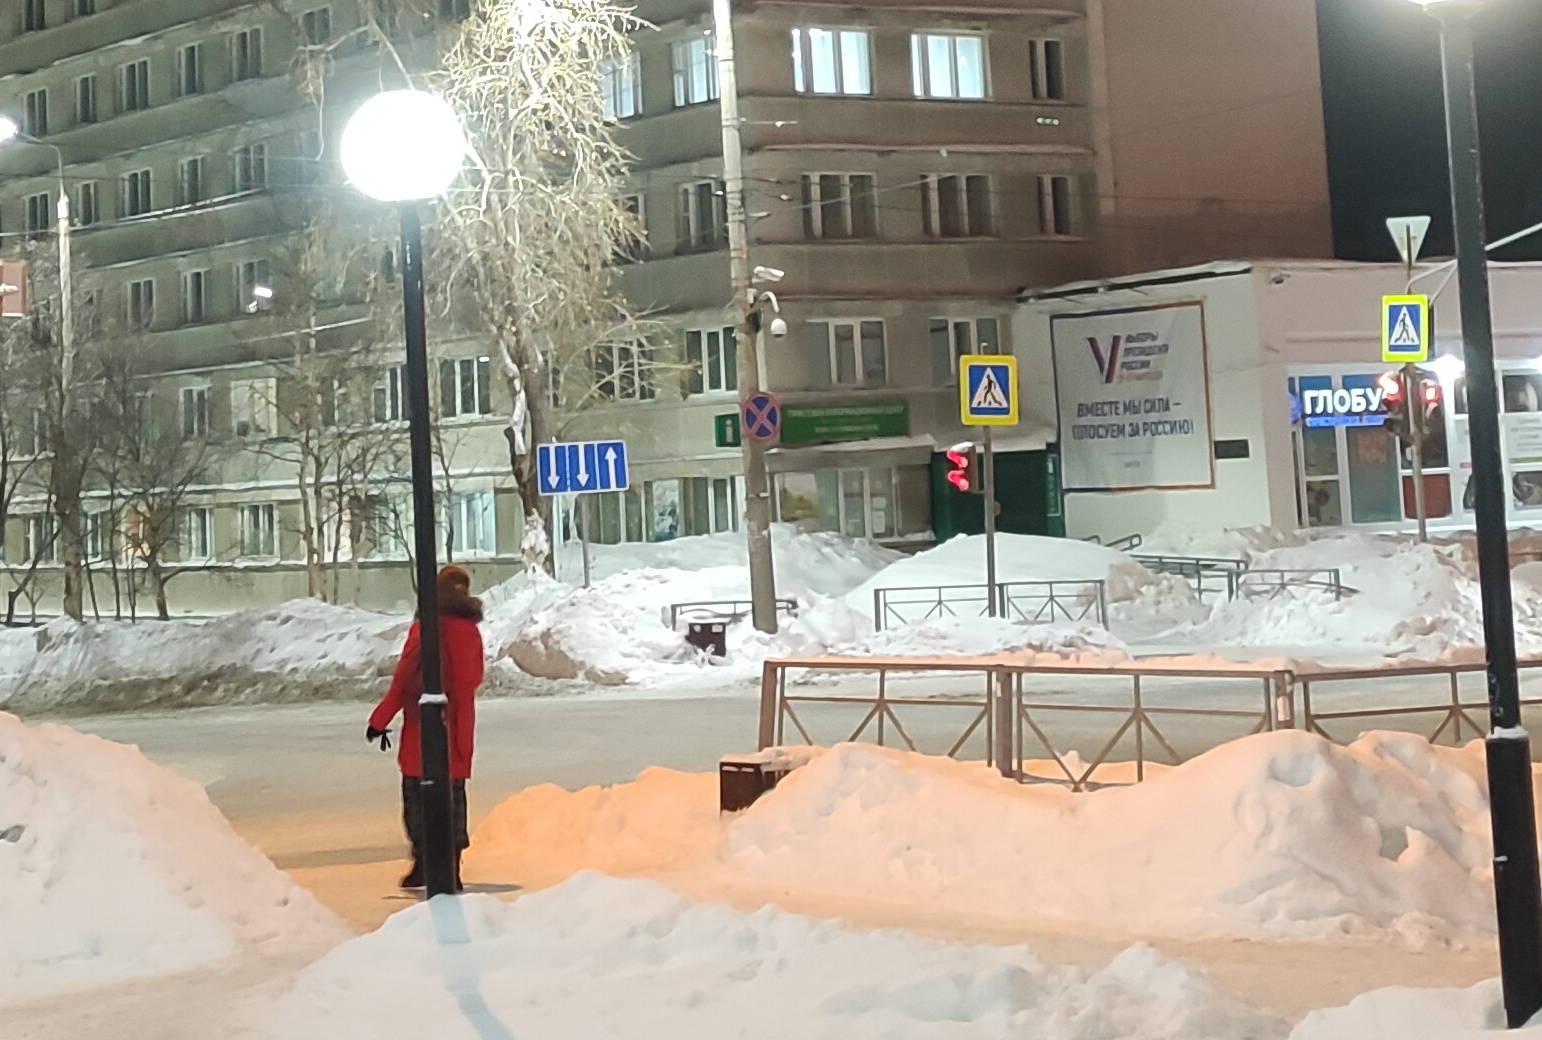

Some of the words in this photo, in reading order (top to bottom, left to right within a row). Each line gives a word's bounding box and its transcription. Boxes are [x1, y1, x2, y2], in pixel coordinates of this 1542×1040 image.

[1077, 400, 1120, 418] ВМЕСТЕ
[1123, 399, 1141, 415] МЫ
[1144, 397, 1171, 414] СИЛА
[1303, 388, 1387, 415] ГЛОБУ
[1072, 423, 1126, 440] ЛОСУЕМ
[1128, 422, 1141, 438] ЗА
[1143, 419, 1194, 437] РОССИЮ!
